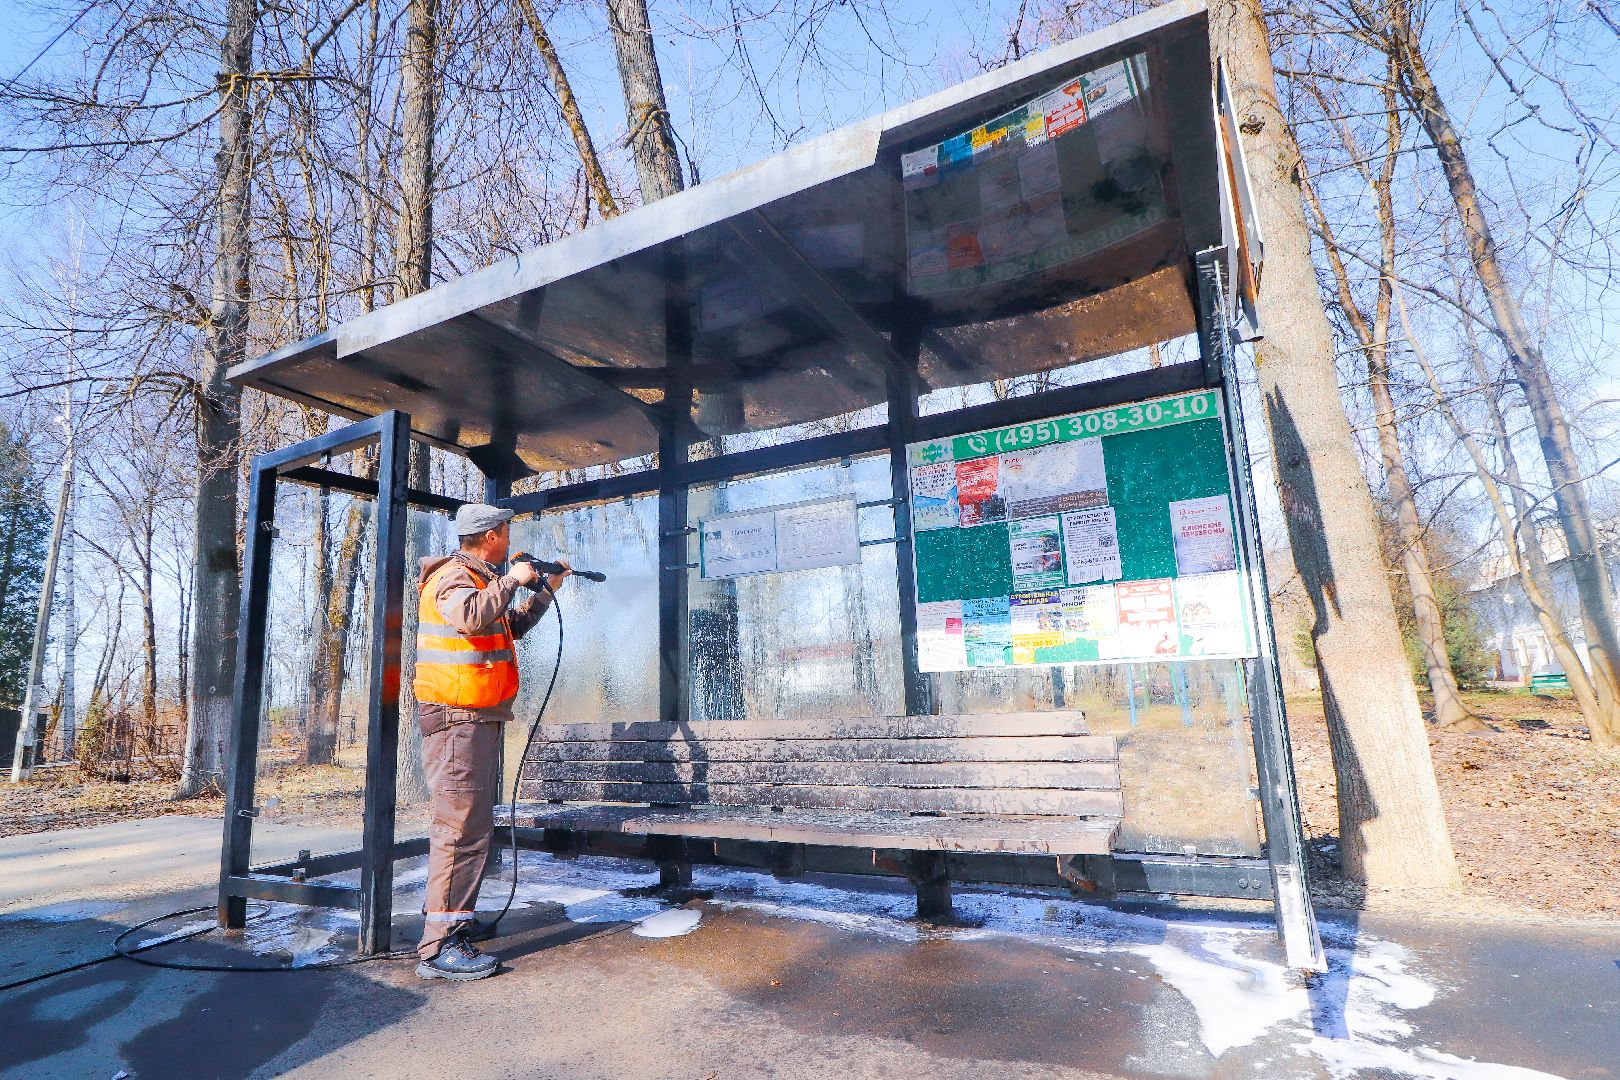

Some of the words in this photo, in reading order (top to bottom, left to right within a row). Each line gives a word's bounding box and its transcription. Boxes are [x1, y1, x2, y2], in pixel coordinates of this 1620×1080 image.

[995, 421, 1060, 452] (495)
[1068, 396, 1209, 436] 308-30-10
[1182, 521, 1222, 532] КЛИНСКИЕ
